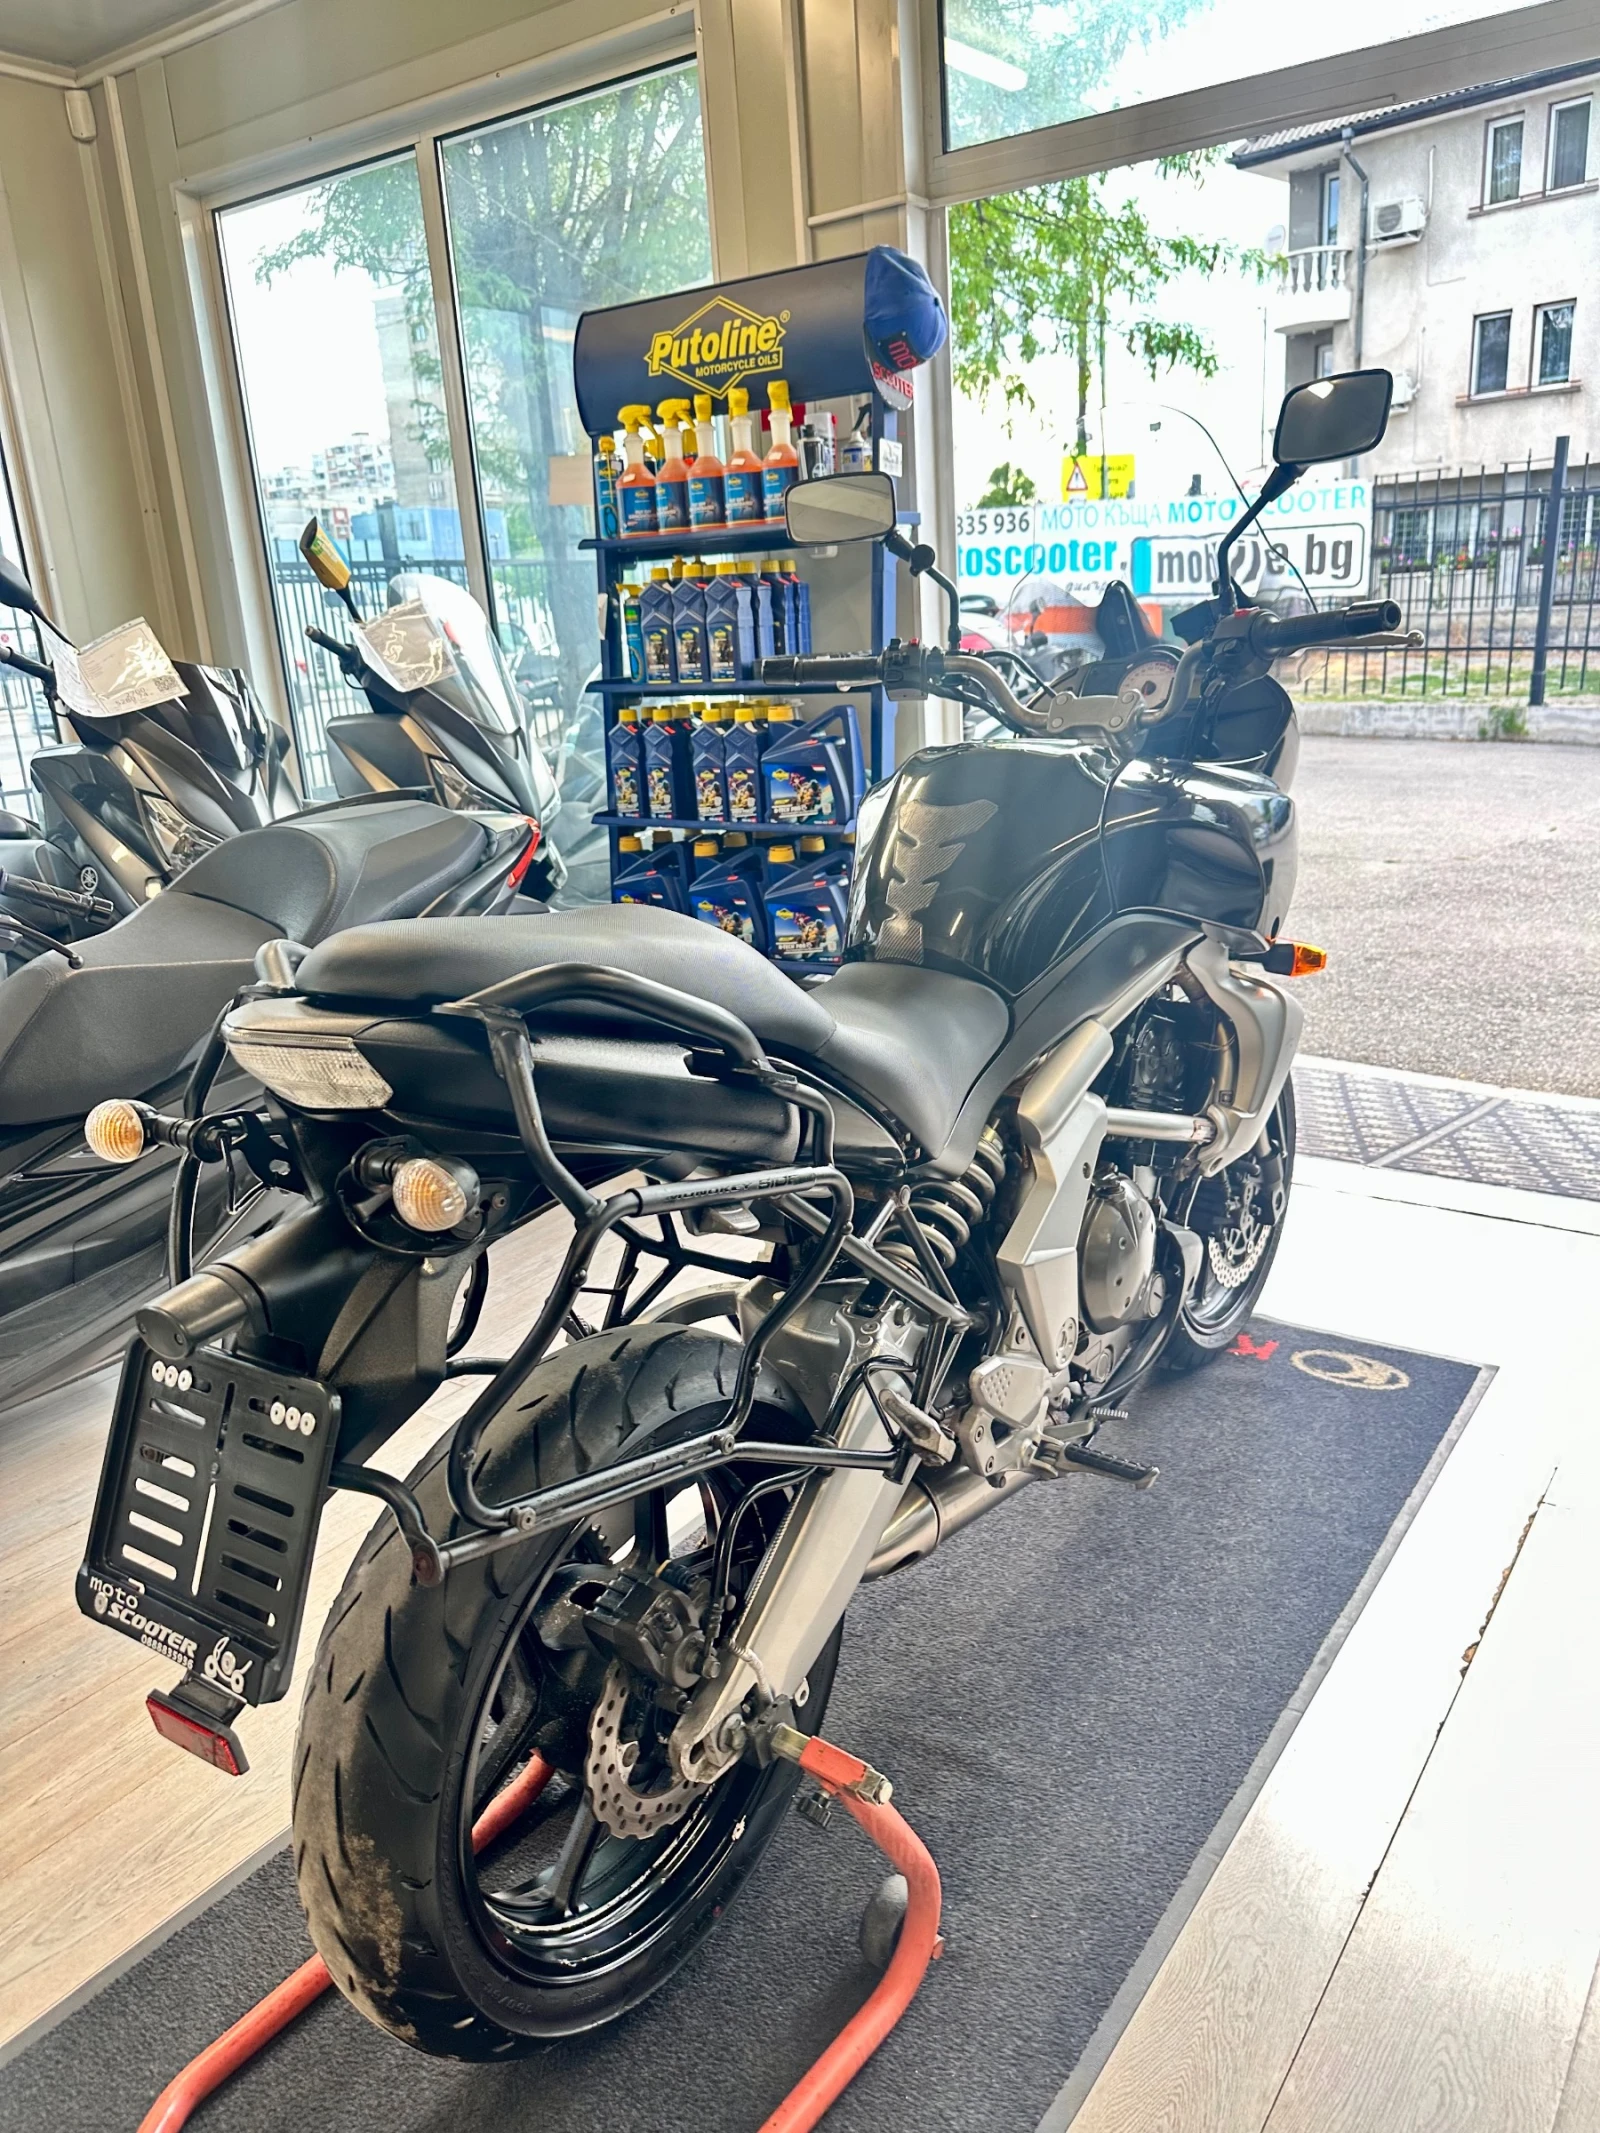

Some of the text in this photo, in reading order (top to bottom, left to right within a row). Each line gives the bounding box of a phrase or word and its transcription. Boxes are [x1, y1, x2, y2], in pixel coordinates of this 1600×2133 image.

[651, 318, 778, 372] Putoline
[695, 353, 779, 377] MOTORCYCLE OILS
[993, 511, 1030, 534] 936
[1104, 502, 1162, 528] КЪЩА
[89, 1575, 139, 1609] moto
[107, 1602, 198, 1658] SCOOTER
[140, 1634, 194, 1670] 0888835936
